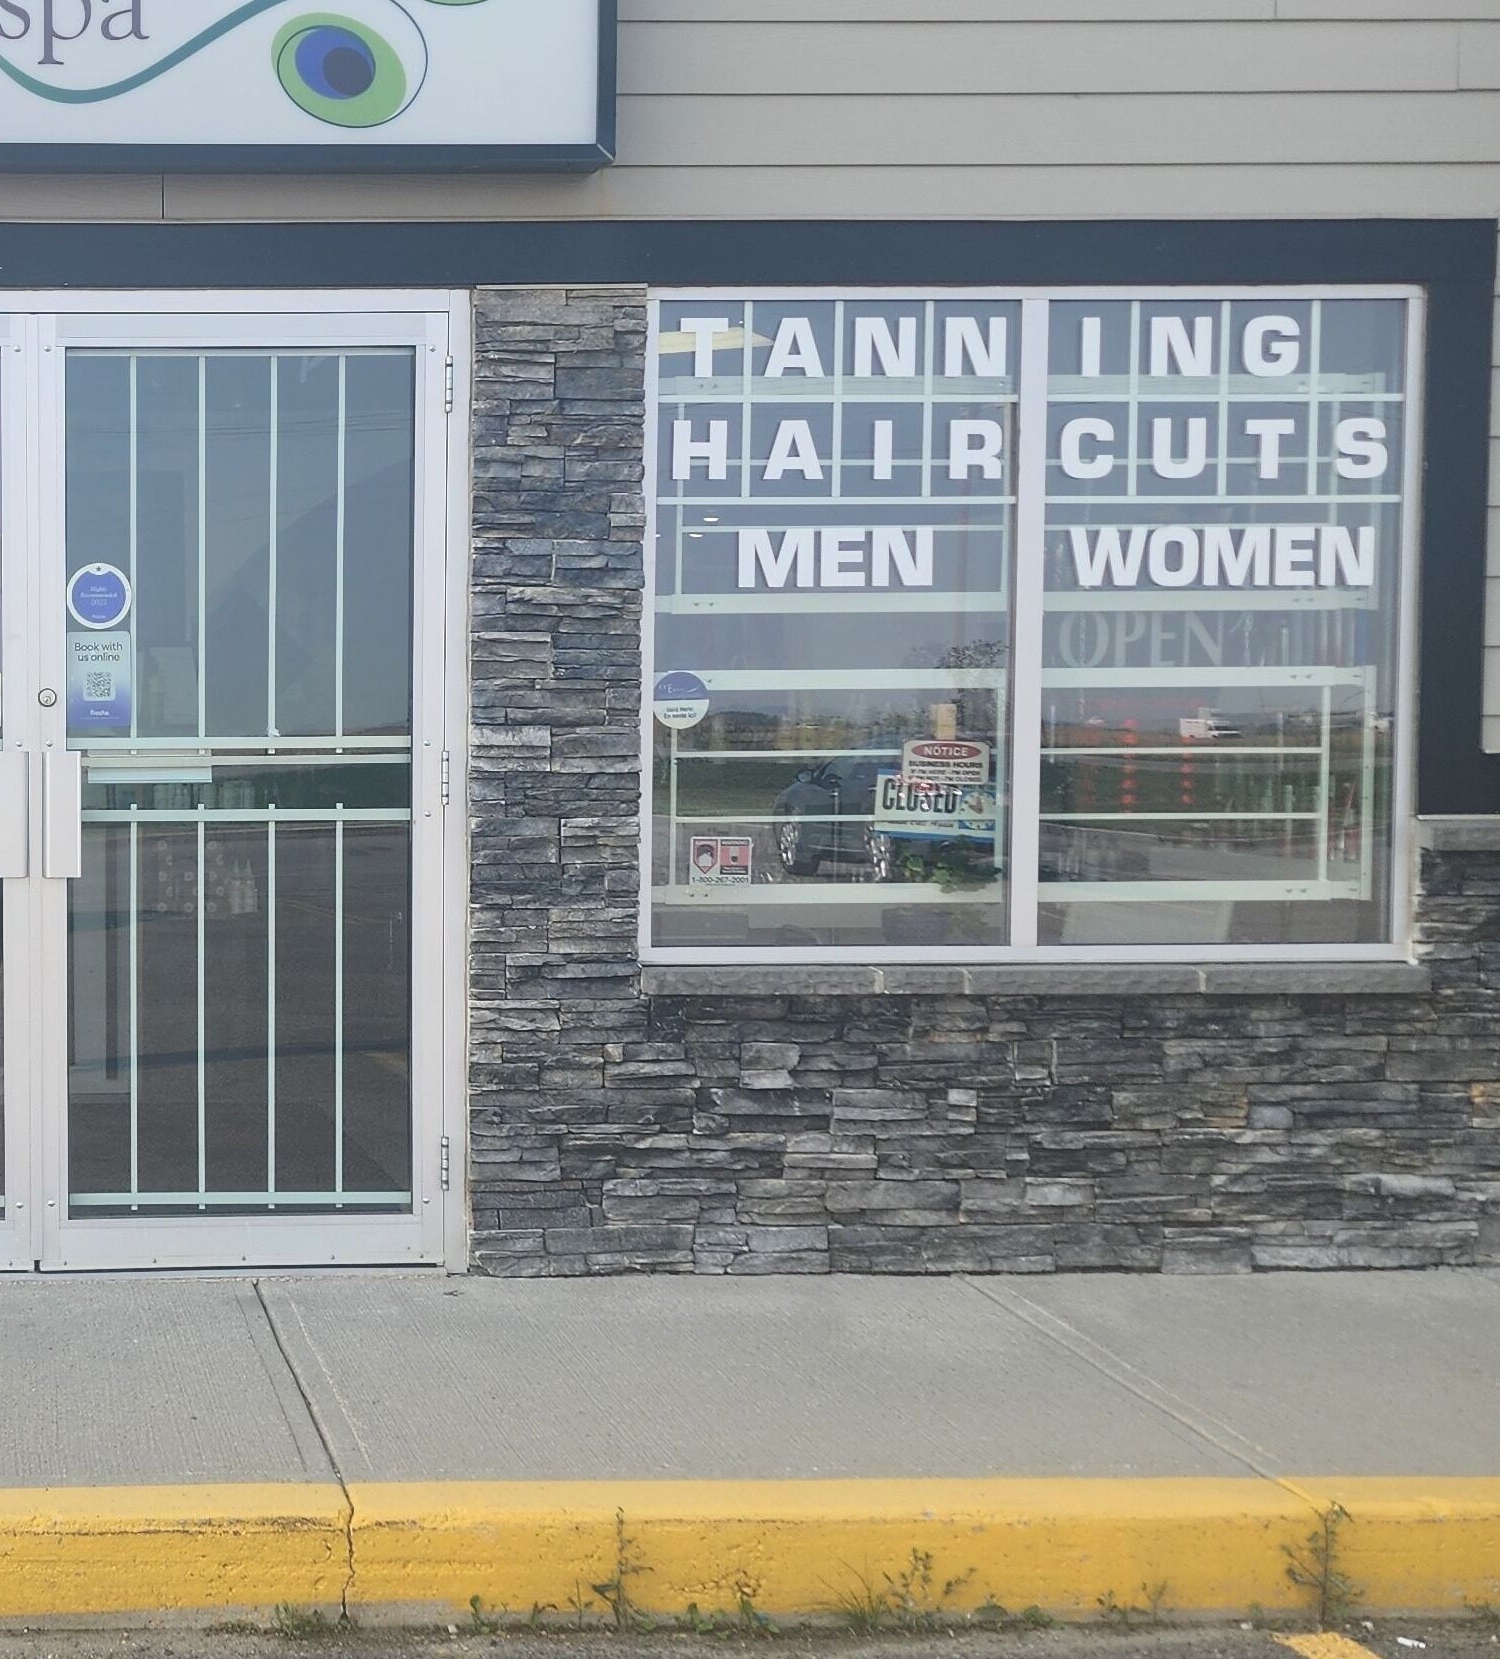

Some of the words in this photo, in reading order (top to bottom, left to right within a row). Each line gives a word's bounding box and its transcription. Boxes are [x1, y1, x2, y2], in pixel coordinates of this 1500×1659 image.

[672, 419, 1003, 480] HAIR
[1059, 417, 1388, 480] CUTS
[737, 526, 934, 588] MEN
[1068, 525, 1376, 588] WOMEN
[74, 642, 100, 652] Book
[101, 642, 123, 652] with
[90, 652, 120, 662] online
[1058, 610, 1224, 669] OPEN
[923, 746, 969, 757] NOTICE
[882, 778, 958, 814] CLOSED
